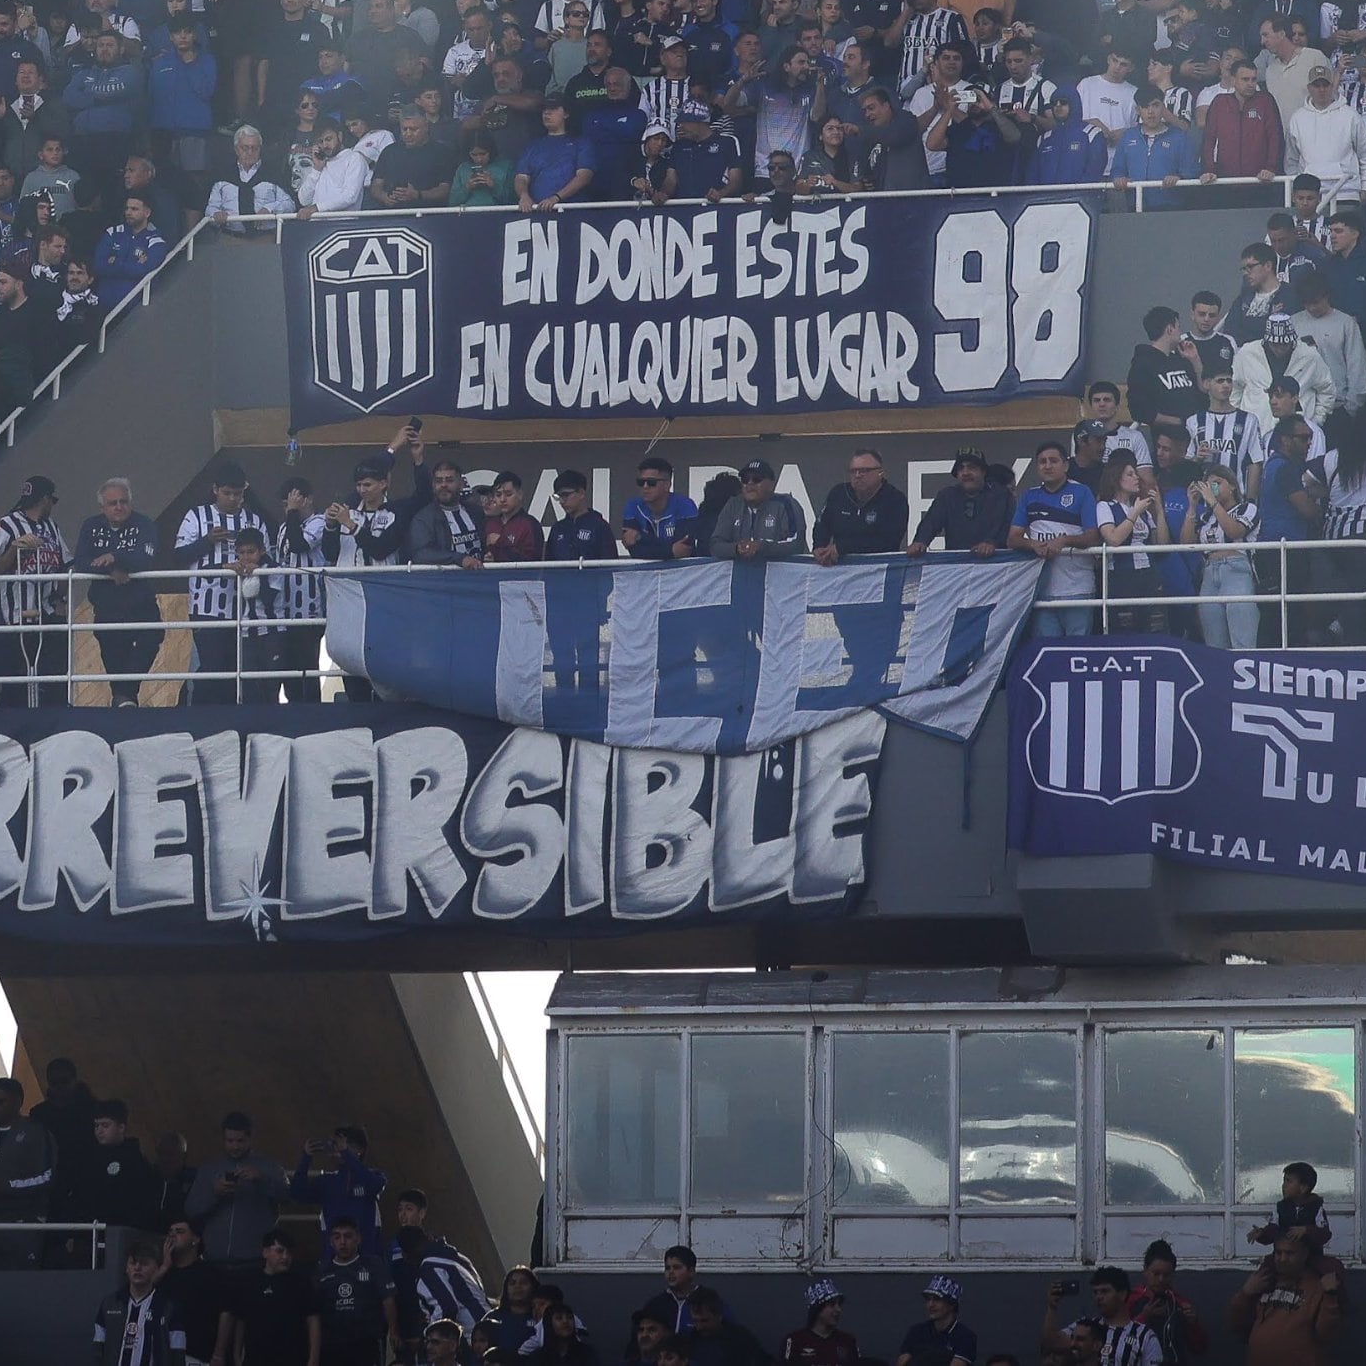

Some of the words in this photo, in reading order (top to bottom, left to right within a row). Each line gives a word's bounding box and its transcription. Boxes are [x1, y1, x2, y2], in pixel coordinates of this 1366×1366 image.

[319, 237, 422, 279] CAT
[503, 218, 559, 305] EN
[576, 211, 718, 304] DONDE
[736, 206, 870, 299] ESTES
[933, 202, 1092, 393] 98
[457, 320, 510, 410] EN
[525, 315, 758, 409] CUALQUIER
[775, 311, 920, 403] LUGAR
[1158, 371, 1193, 391] VANS
[1071, 656, 1152, 672] C.A.T
[1151, 822, 1275, 863] FILIAL
